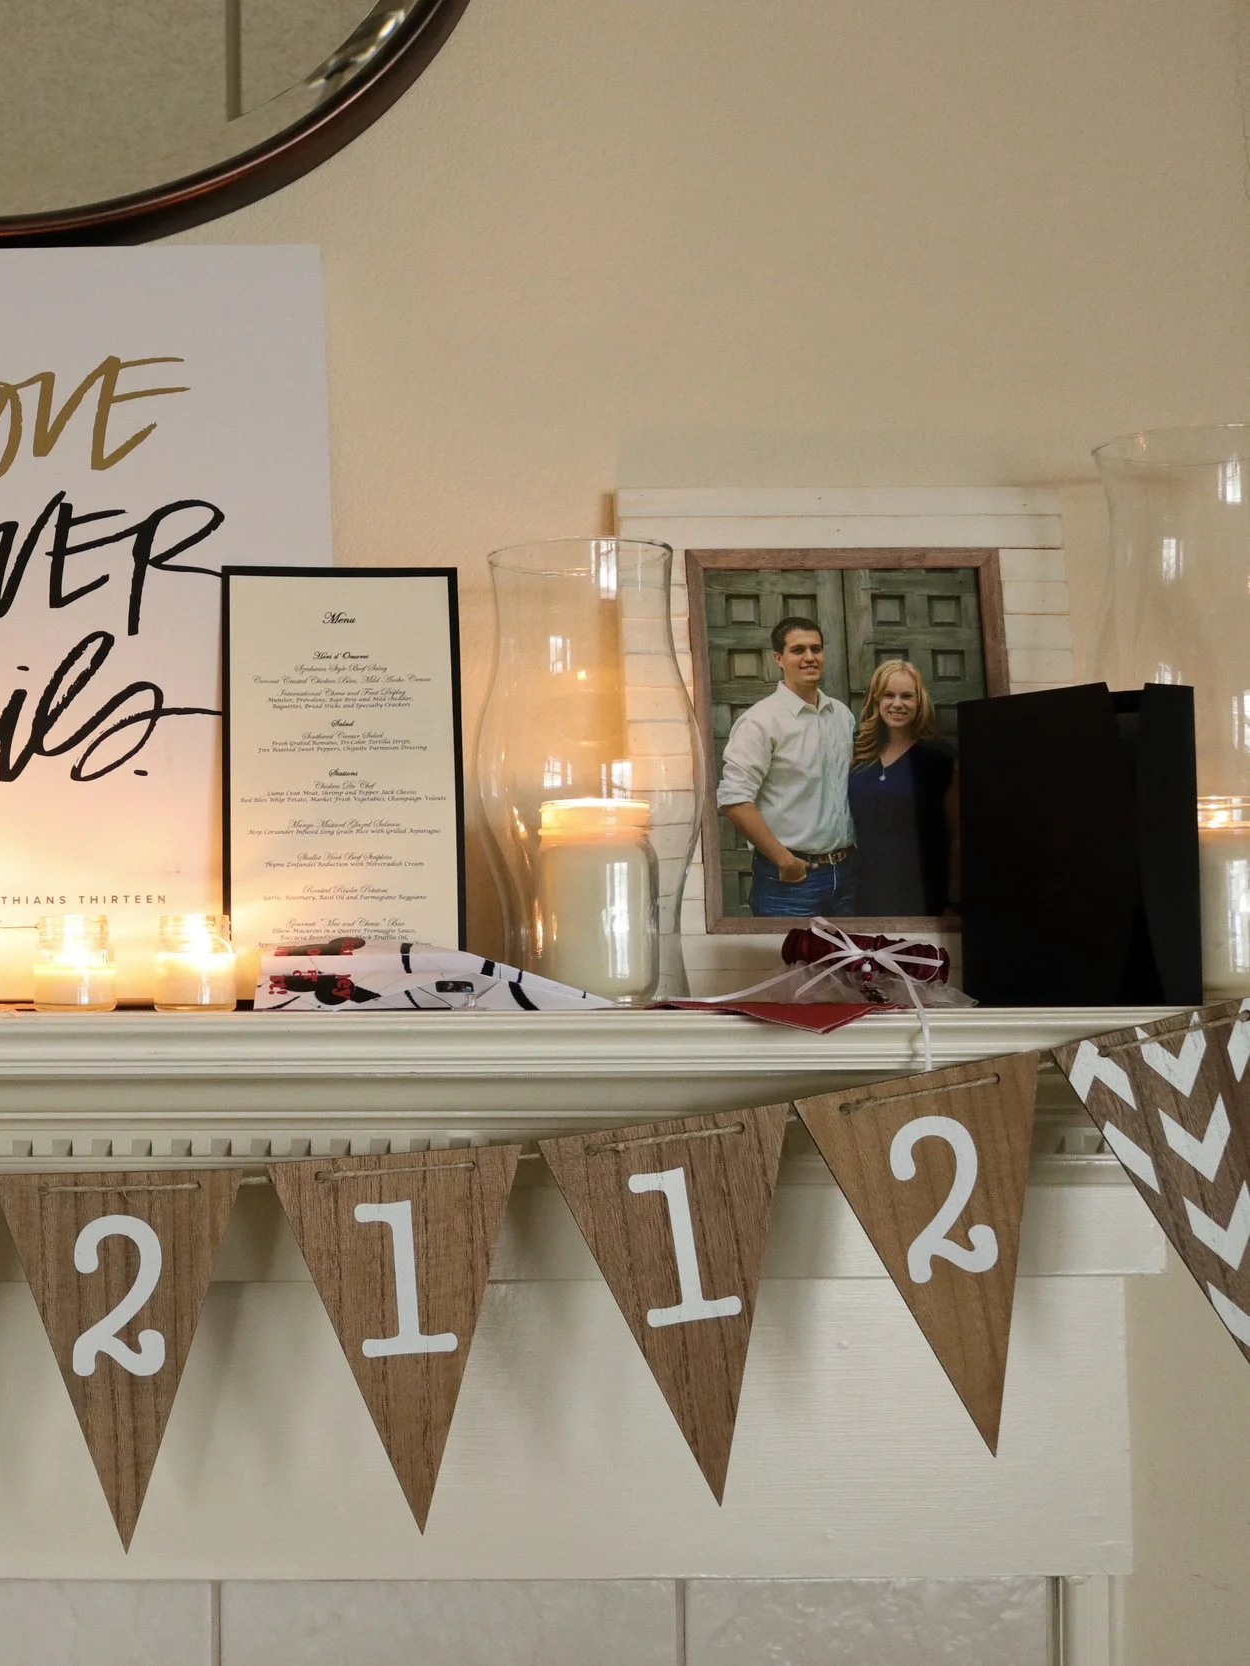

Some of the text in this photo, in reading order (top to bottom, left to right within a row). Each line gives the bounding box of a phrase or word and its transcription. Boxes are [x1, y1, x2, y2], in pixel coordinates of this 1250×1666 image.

[322, 611, 356, 624] Menu
[331, 719, 355, 727] Salad
[328, 768, 358, 777] Stations
[78, 895, 166, 905] THIRTEEN
[71, 1214, 166, 1377] 2
[888, 1114, 998, 1284] 2
